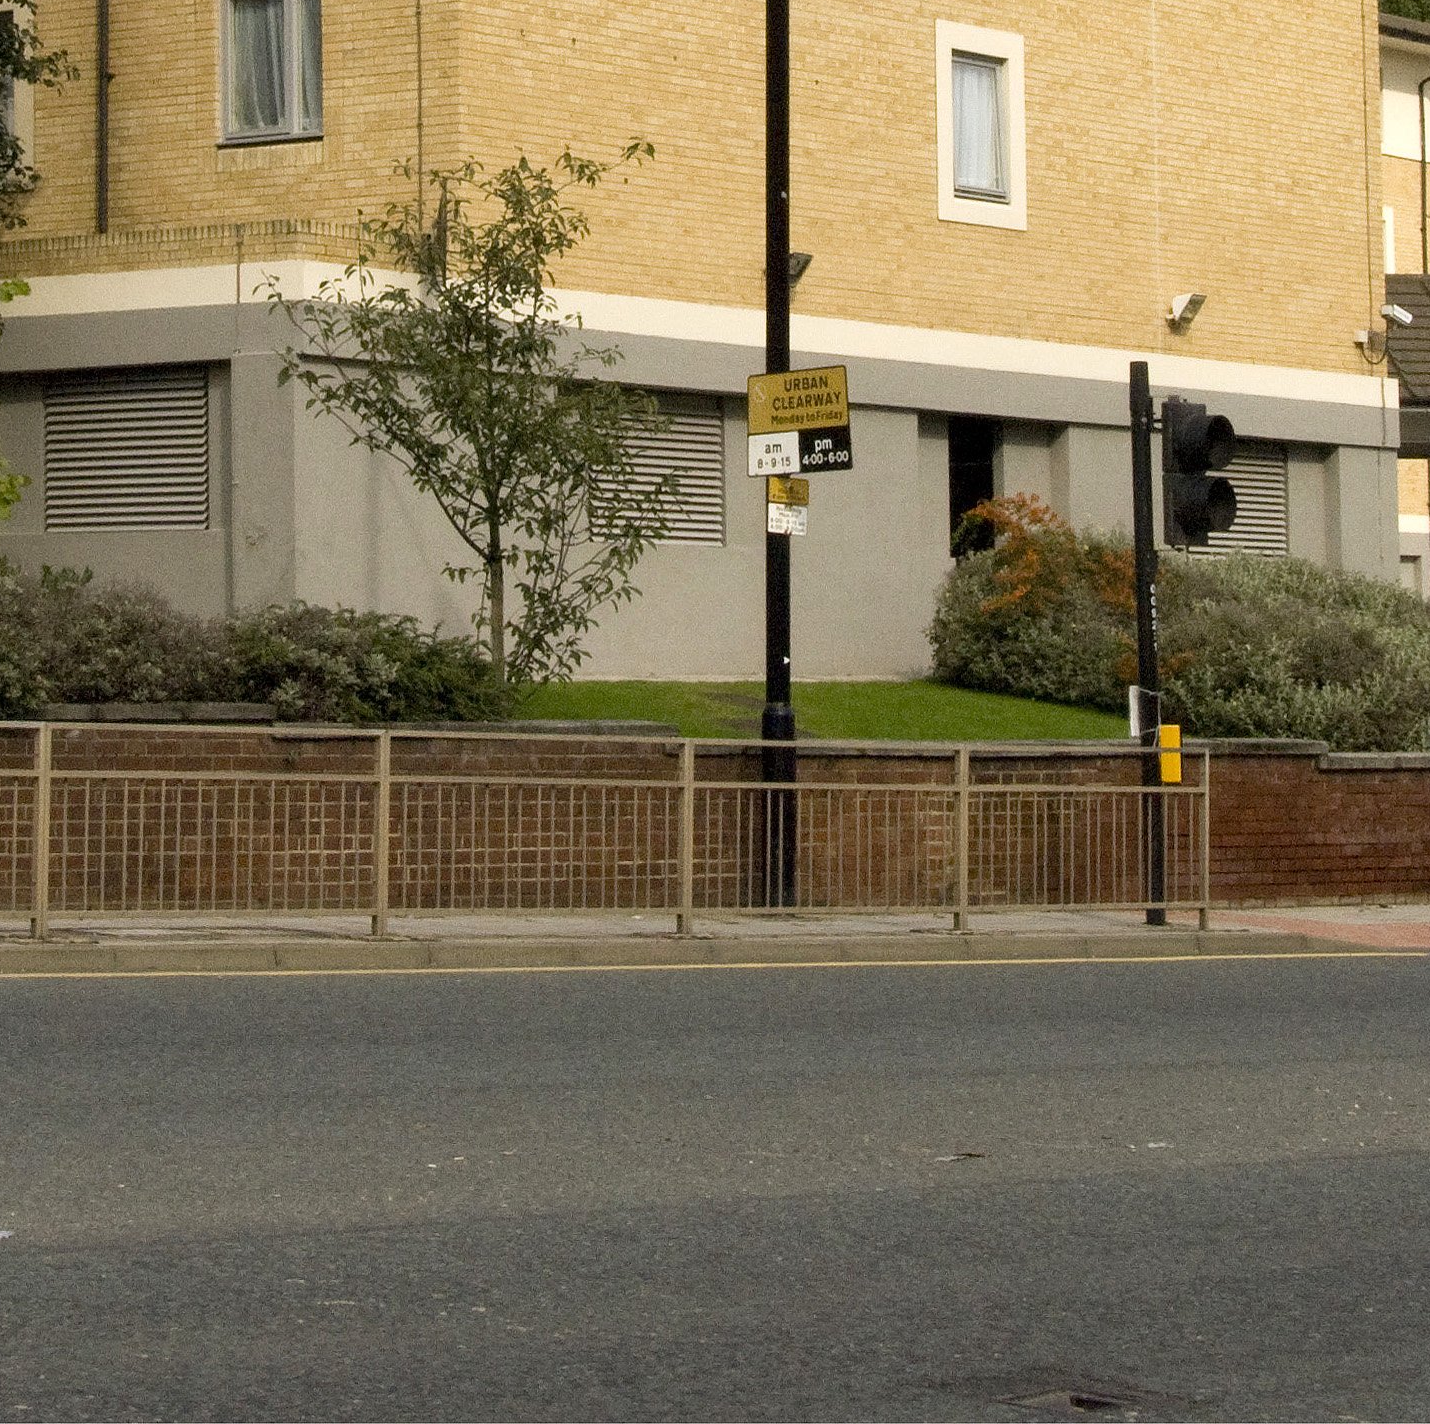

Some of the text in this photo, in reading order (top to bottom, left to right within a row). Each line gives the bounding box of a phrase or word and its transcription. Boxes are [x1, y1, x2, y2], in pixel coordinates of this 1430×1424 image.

[784, 376, 828, 392] URBAN
[772, 391, 842, 411] CLEARWAY
[765, 443, 782, 454] am
[815, 438, 832, 453] pm
